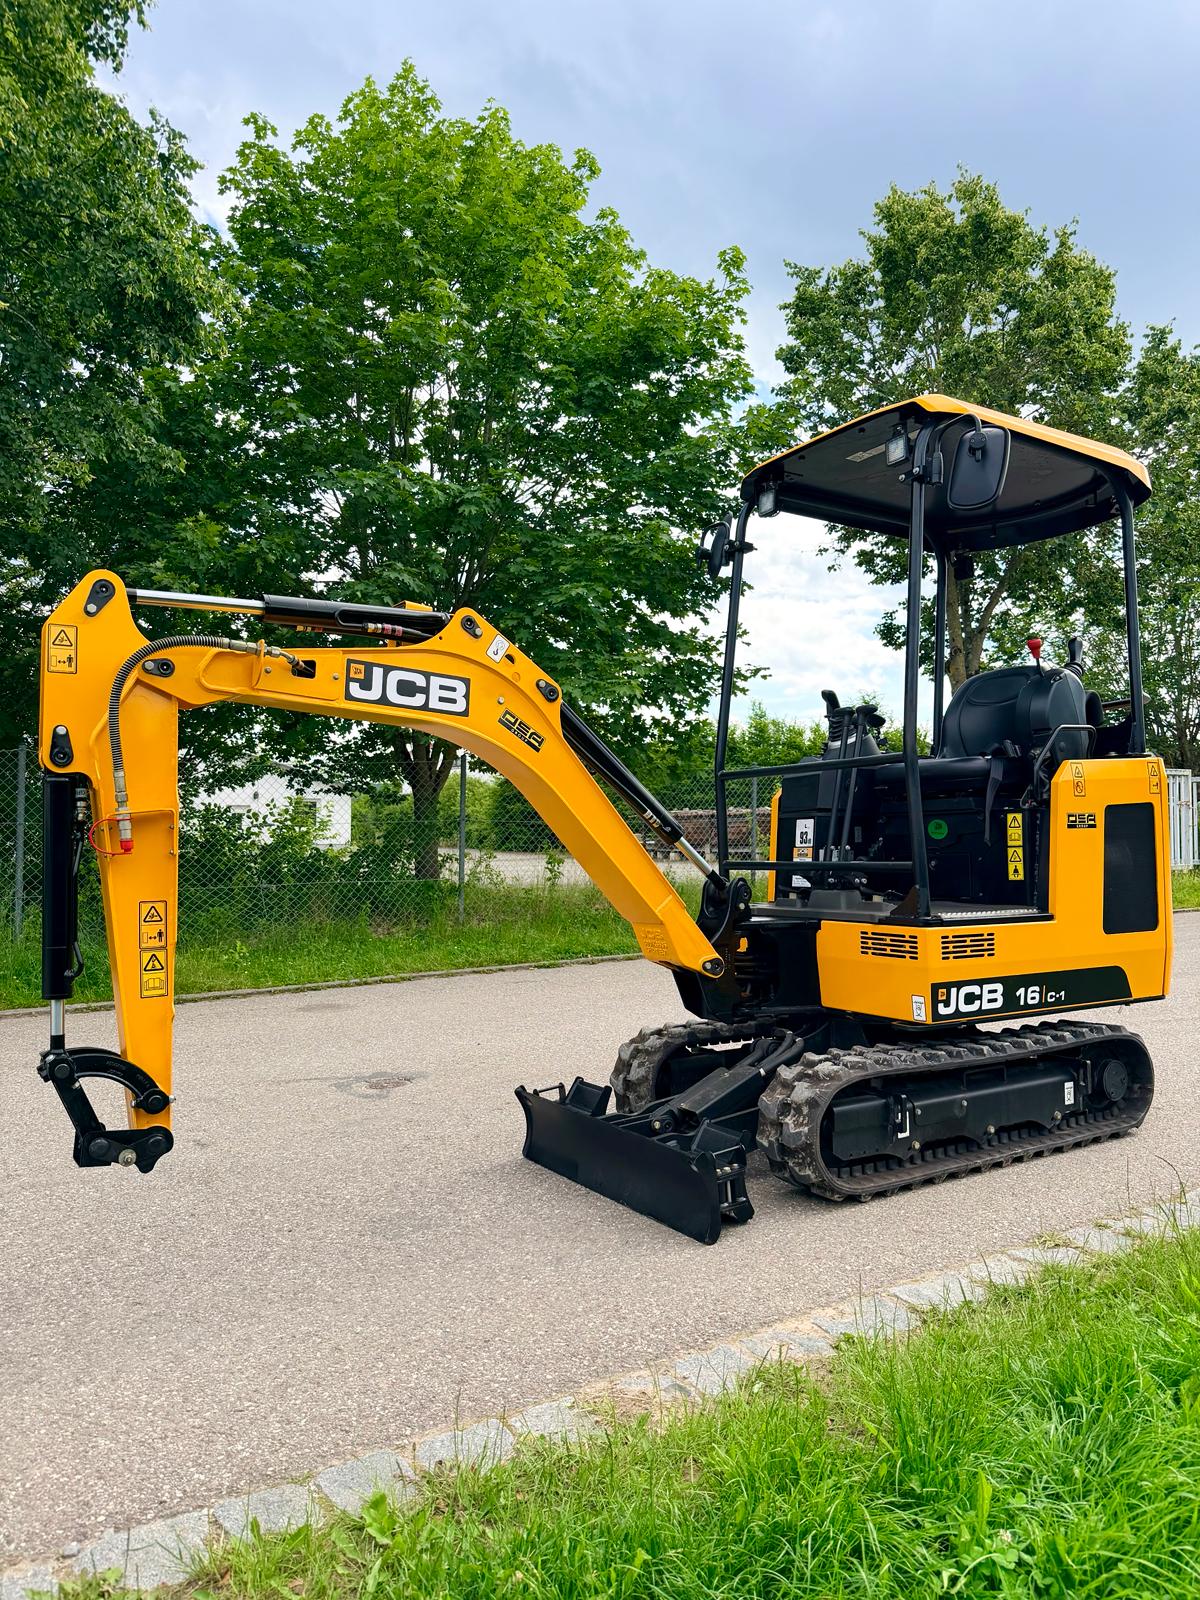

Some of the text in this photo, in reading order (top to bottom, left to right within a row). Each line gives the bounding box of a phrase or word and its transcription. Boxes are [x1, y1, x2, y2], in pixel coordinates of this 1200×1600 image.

[349, 666, 467, 713] JCB
[938, 983, 1004, 1015] JCB
[1015, 985, 1040, 1006] 16
